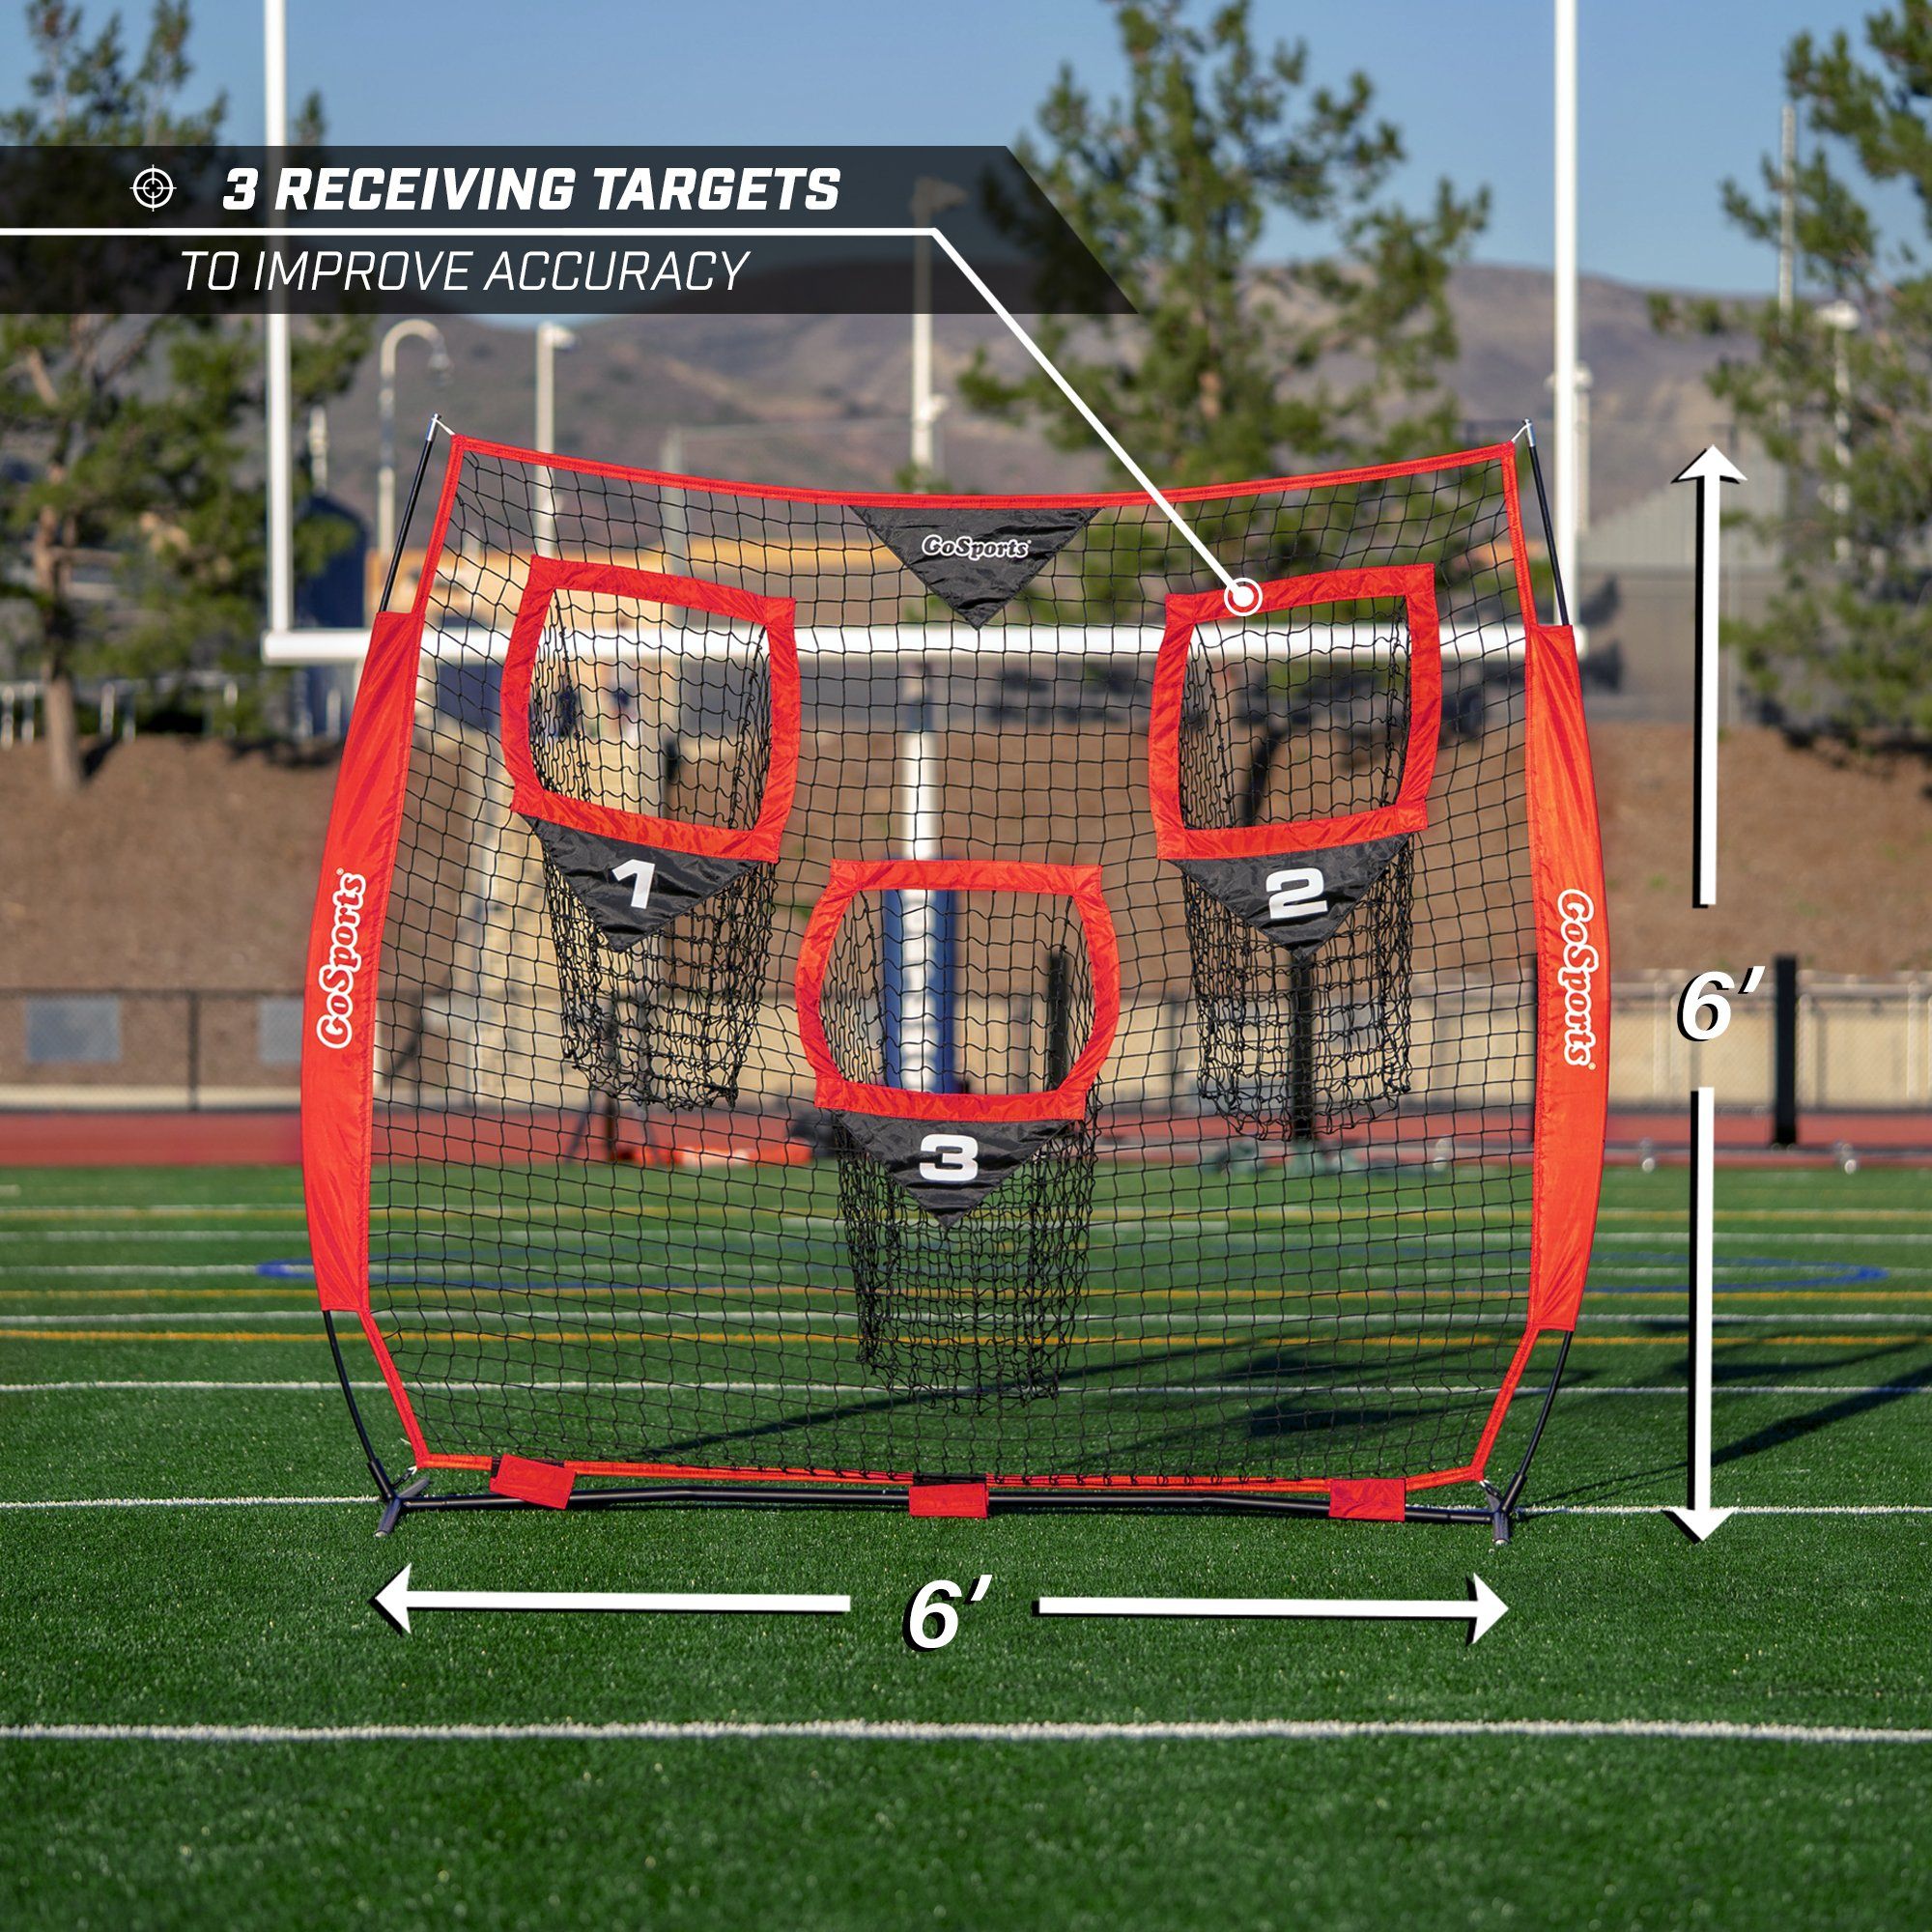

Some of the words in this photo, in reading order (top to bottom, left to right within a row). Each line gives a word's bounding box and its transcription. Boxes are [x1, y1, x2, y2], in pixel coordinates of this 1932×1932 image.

[921, 533, 1030, 561] GoSports
[611, 859, 656, 910] 1
[1265, 867, 1328, 920] 2
[316, 871, 366, 1049] GoSports
[1557, 889, 1600, 1066] GoSports
[919, 1133, 979, 1181] 3
